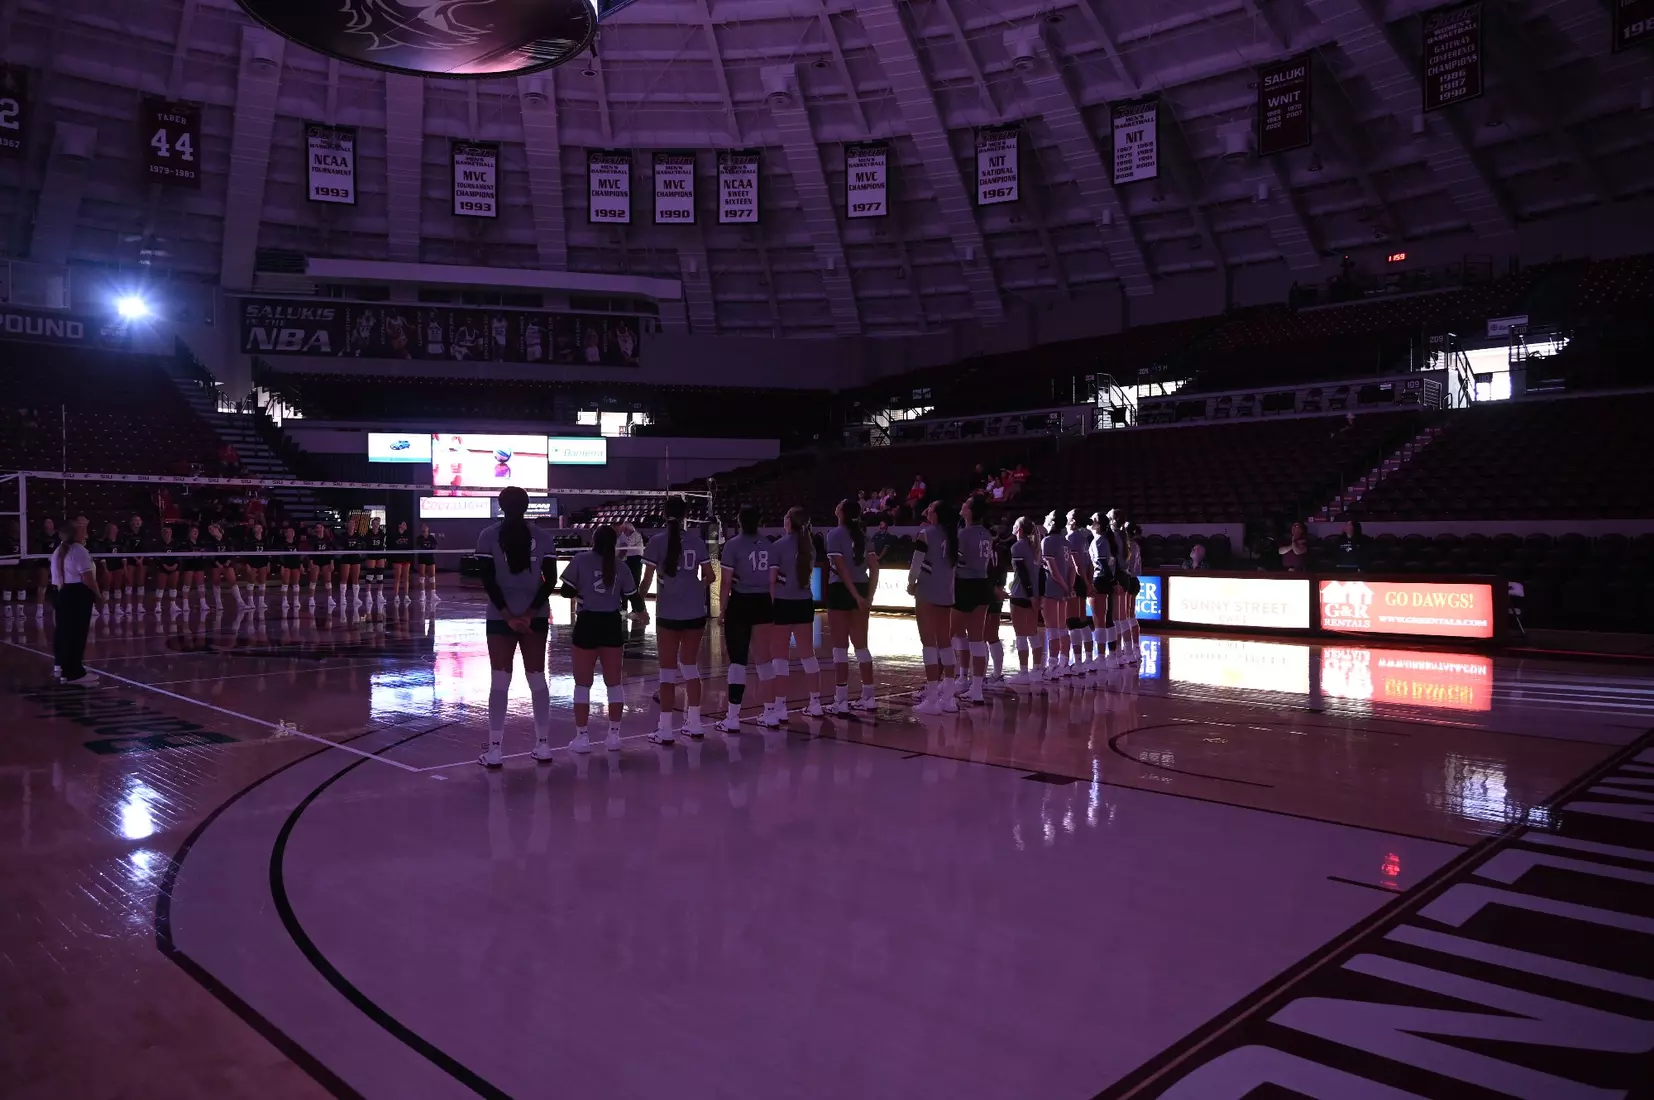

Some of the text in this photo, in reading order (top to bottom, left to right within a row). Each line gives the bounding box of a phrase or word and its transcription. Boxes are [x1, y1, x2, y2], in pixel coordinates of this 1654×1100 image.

[1434, 35, 1470, 54] GATEWAY
[1429, 43, 1477, 65] CONFERENCE
[1427, 55, 1478, 77] CHAMPIONS
[1264, 66, 1305, 86] SALUKI
[1267, 90, 1301, 108] WNIT
[1440, 87, 1467, 101] 1990
[1115, 117, 1154, 129] BASKETBALL
[1126, 130, 1144, 144] NIT
[150, 128, 194, 162] 44
[314, 154, 348, 167] NCAA
[989, 155, 1006, 167] NIT
[312, 167, 351, 176] TOURNAMENT
[463, 171, 487, 182] MVC
[855, 171, 878, 182] MVC
[982, 167, 1013, 176] NATIONAL
[598, 179, 621, 189] MVC
[663, 179, 685, 190] MVC
[723, 179, 753, 189] NCAA
[979, 175, 1016, 186] CHAMPIONS
[849, 182, 885, 191] CHAMPIONS
[315, 187, 349, 198] 1993
[456, 190, 494, 199] CHAMPIONS
[982, 187, 1014, 199] 1967
[460, 202, 491, 211] 1993
[852, 202, 881, 212] 1977
[594, 209, 626, 218] 1992
[659, 210, 691, 218] 1990
[723, 209, 753, 218] 1977
[246, 304, 336, 321] SALUKIS
[0, 313, 84, 339] OUND
[246, 326, 332, 353] NBA
[1429, 335, 1444, 344] 209
[1407, 379, 1420, 389] 109
[748, 550, 769, 571] 18
[1385, 592, 1474, 609] GO DAWGS!
[1181, 599, 1288, 614] SUNNY STREET
[1325, 603, 1370, 618] G&R
[1324, 618, 1371, 628] RENTALS
